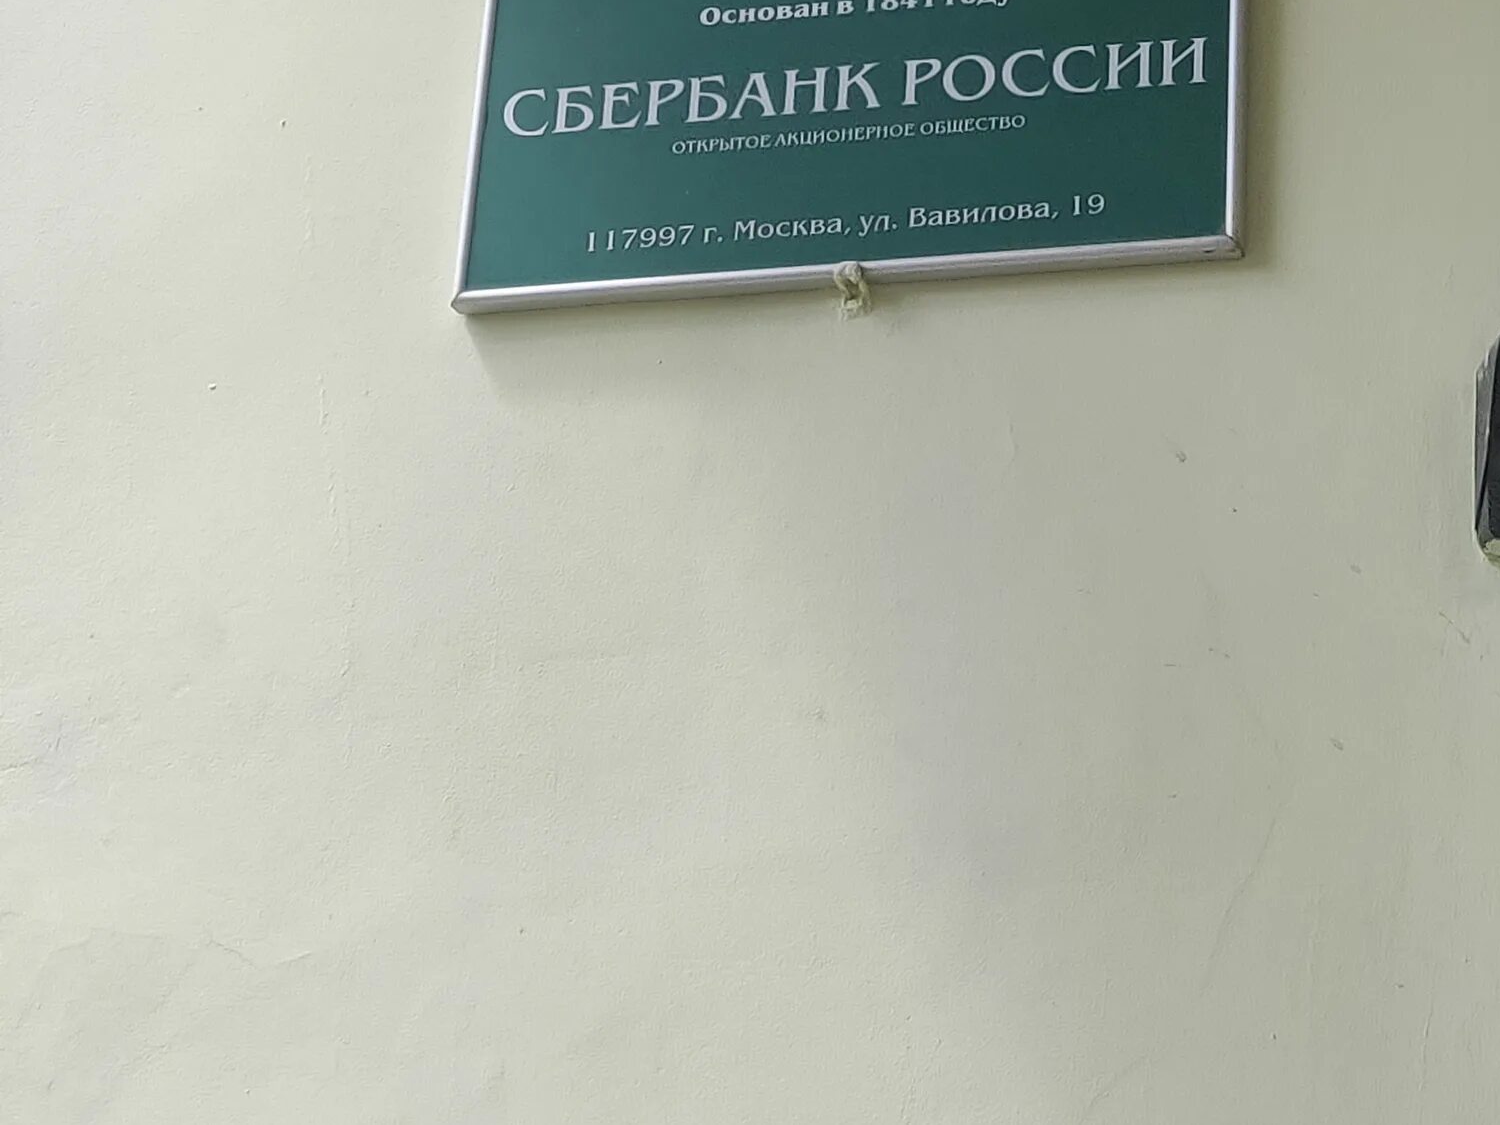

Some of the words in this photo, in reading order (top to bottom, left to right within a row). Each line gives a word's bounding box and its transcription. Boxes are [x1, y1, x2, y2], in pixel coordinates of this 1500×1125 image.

[502, 61, 881, 139] СБЕРБАНК
[902, 36, 1209, 107] РОССИИ
[671, 132, 773, 156] ОТКРЫТОЕ
[774, 122, 916, 151] АКЦИОНЕРНОЕ
[919, 113, 1027, 140] ОБЩЕСТВО
[585, 224, 694, 255] 117997
[702, 226, 725, 245] г.
[732, 211, 852, 243] Москва,
[858, 208, 900, 238] ул.
[907, 197, 1060, 230] Вавилова,
[1071, 193, 1107, 218] 19
